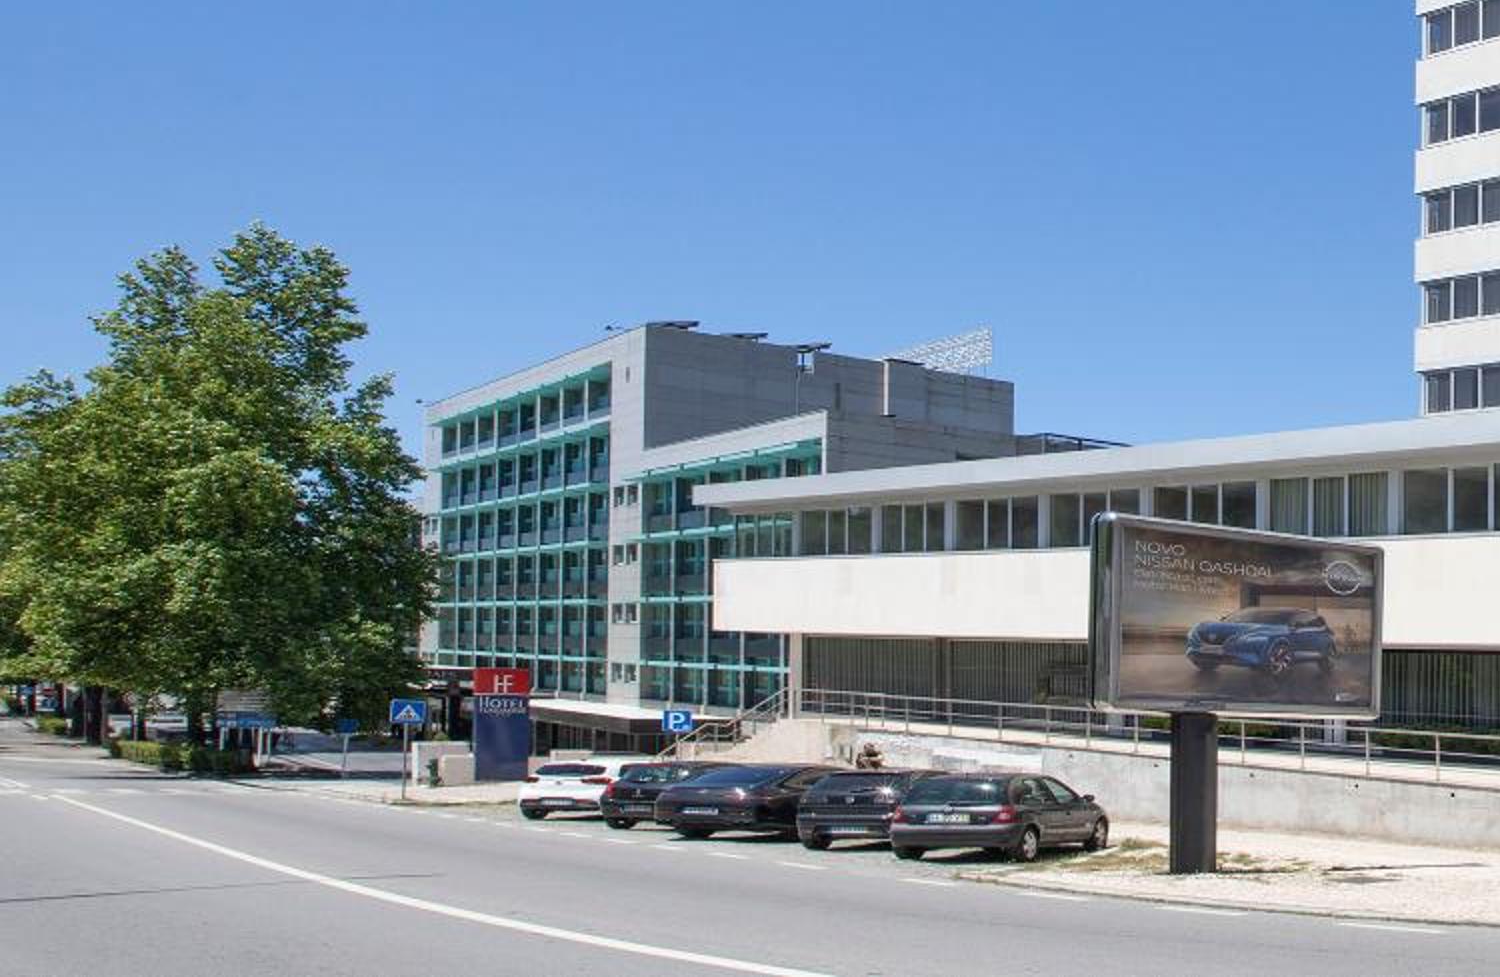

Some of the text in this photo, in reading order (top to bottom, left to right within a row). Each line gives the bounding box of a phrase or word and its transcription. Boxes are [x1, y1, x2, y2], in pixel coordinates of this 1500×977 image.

[1135, 540, 1185, 556] NOVO
[1135, 554, 1272, 577] NISSAN QASHQAI
[494, 674, 513, 693] HF
[669, 712, 686, 730] P
